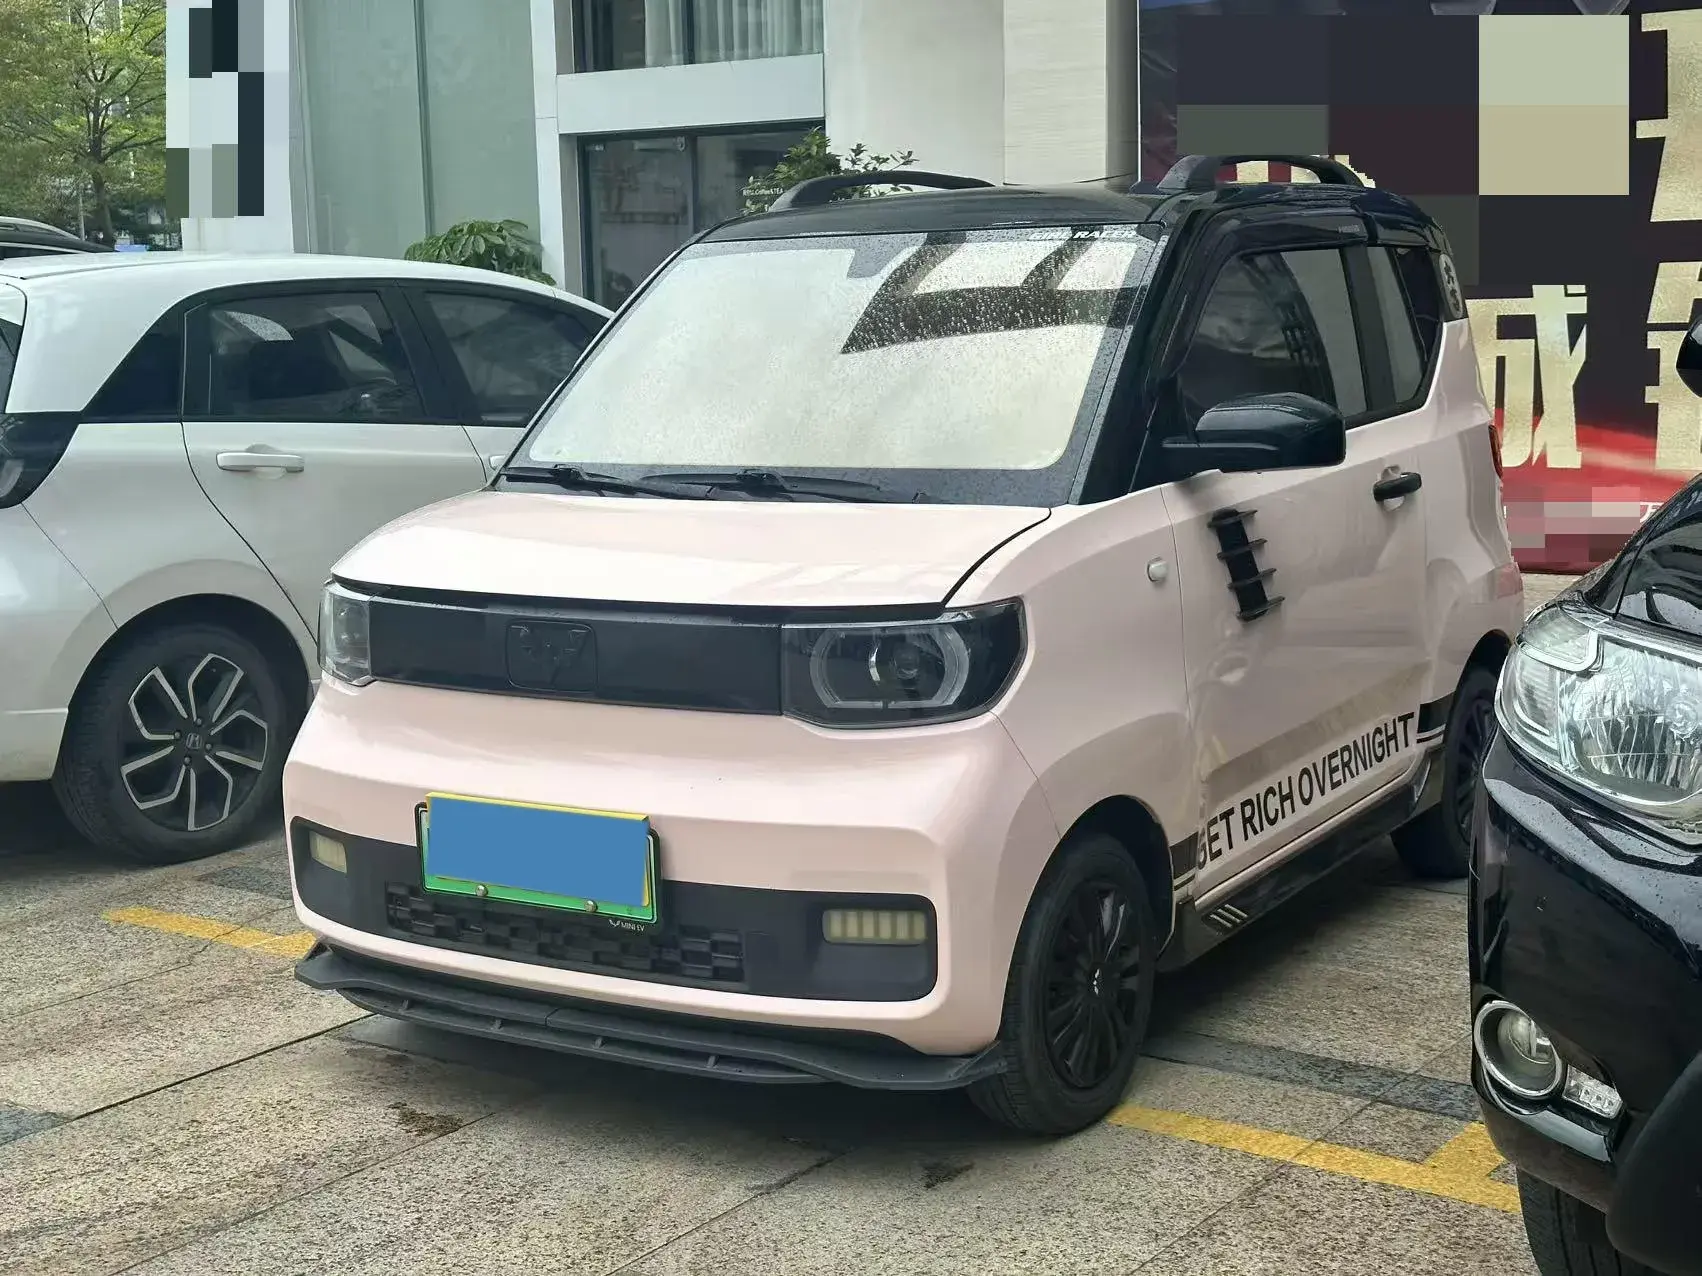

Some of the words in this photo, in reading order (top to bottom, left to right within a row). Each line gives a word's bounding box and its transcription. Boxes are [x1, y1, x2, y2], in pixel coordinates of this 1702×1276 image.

[1073, 230, 1137, 239] RACER
[1240, 775, 1296, 842] RICH
[1298, 711, 1415, 806] OVERNIGHT
[621, 921, 636, 931] MINI
